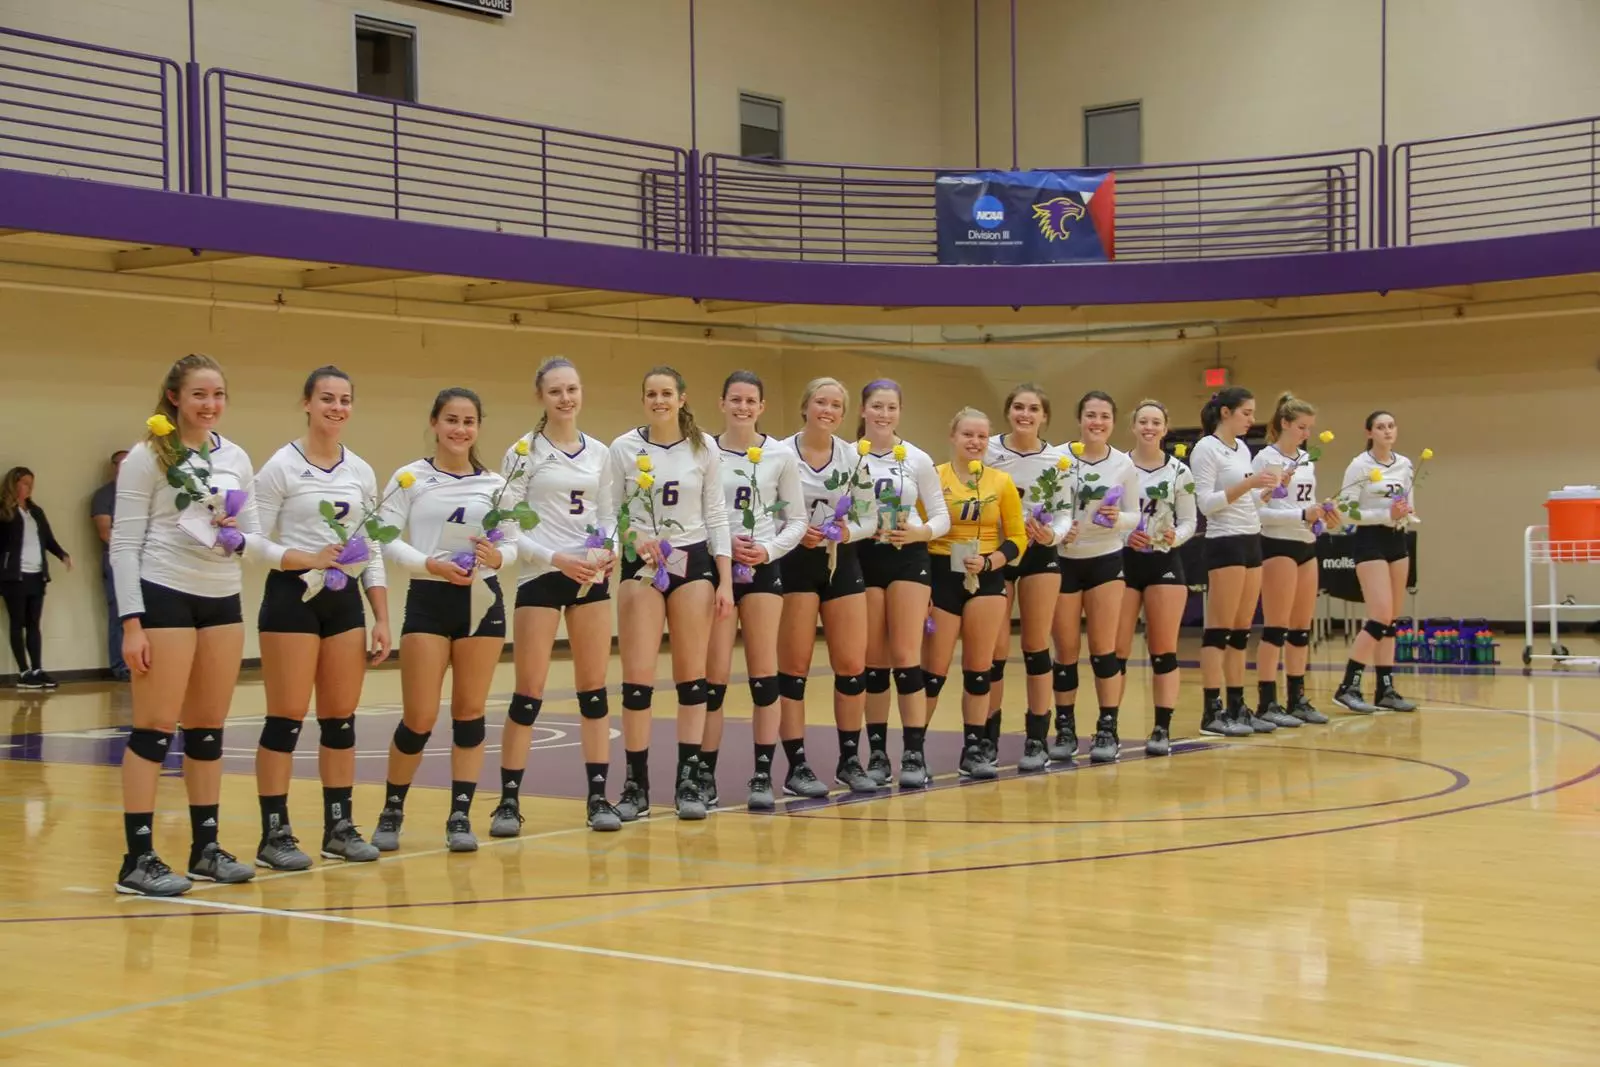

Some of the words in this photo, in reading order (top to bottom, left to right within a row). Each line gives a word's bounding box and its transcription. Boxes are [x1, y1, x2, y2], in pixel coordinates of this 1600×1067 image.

[976, 210, 1004, 220] NCAA
[968, 229, 1001, 240] Division
[1002, 230, 1010, 240] III
[569, 490, 585, 515] 5
[662, 480, 680, 507] 6
[733, 486, 752, 510] 8
[1296, 483, 1312, 501] 22
[334, 501, 351, 527] 2
[446, 506, 467, 525] 4
